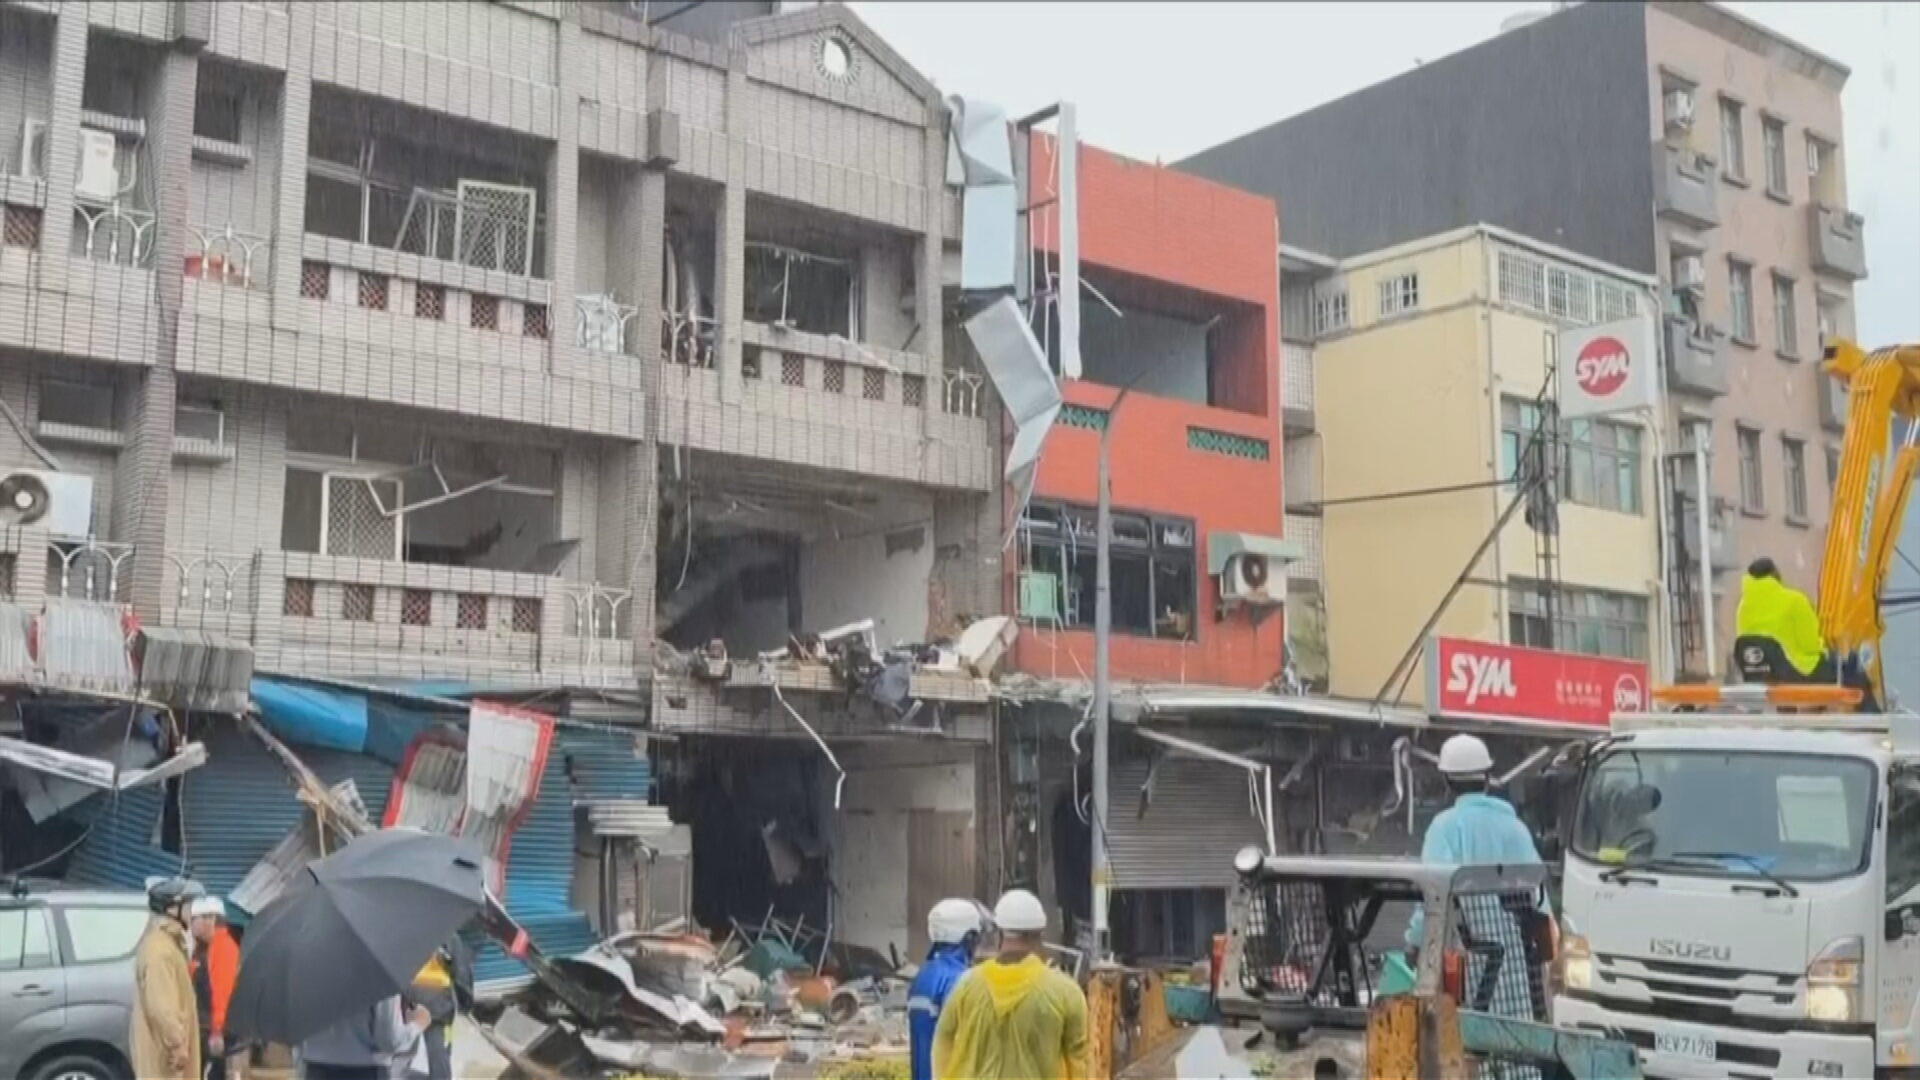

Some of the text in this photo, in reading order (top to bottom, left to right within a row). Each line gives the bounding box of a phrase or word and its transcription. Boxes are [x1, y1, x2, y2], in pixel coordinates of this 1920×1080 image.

[1575, 352, 1630, 387] SYM
[1447, 653, 1517, 705] SYM
[1650, 938, 1732, 960] ISUZU
